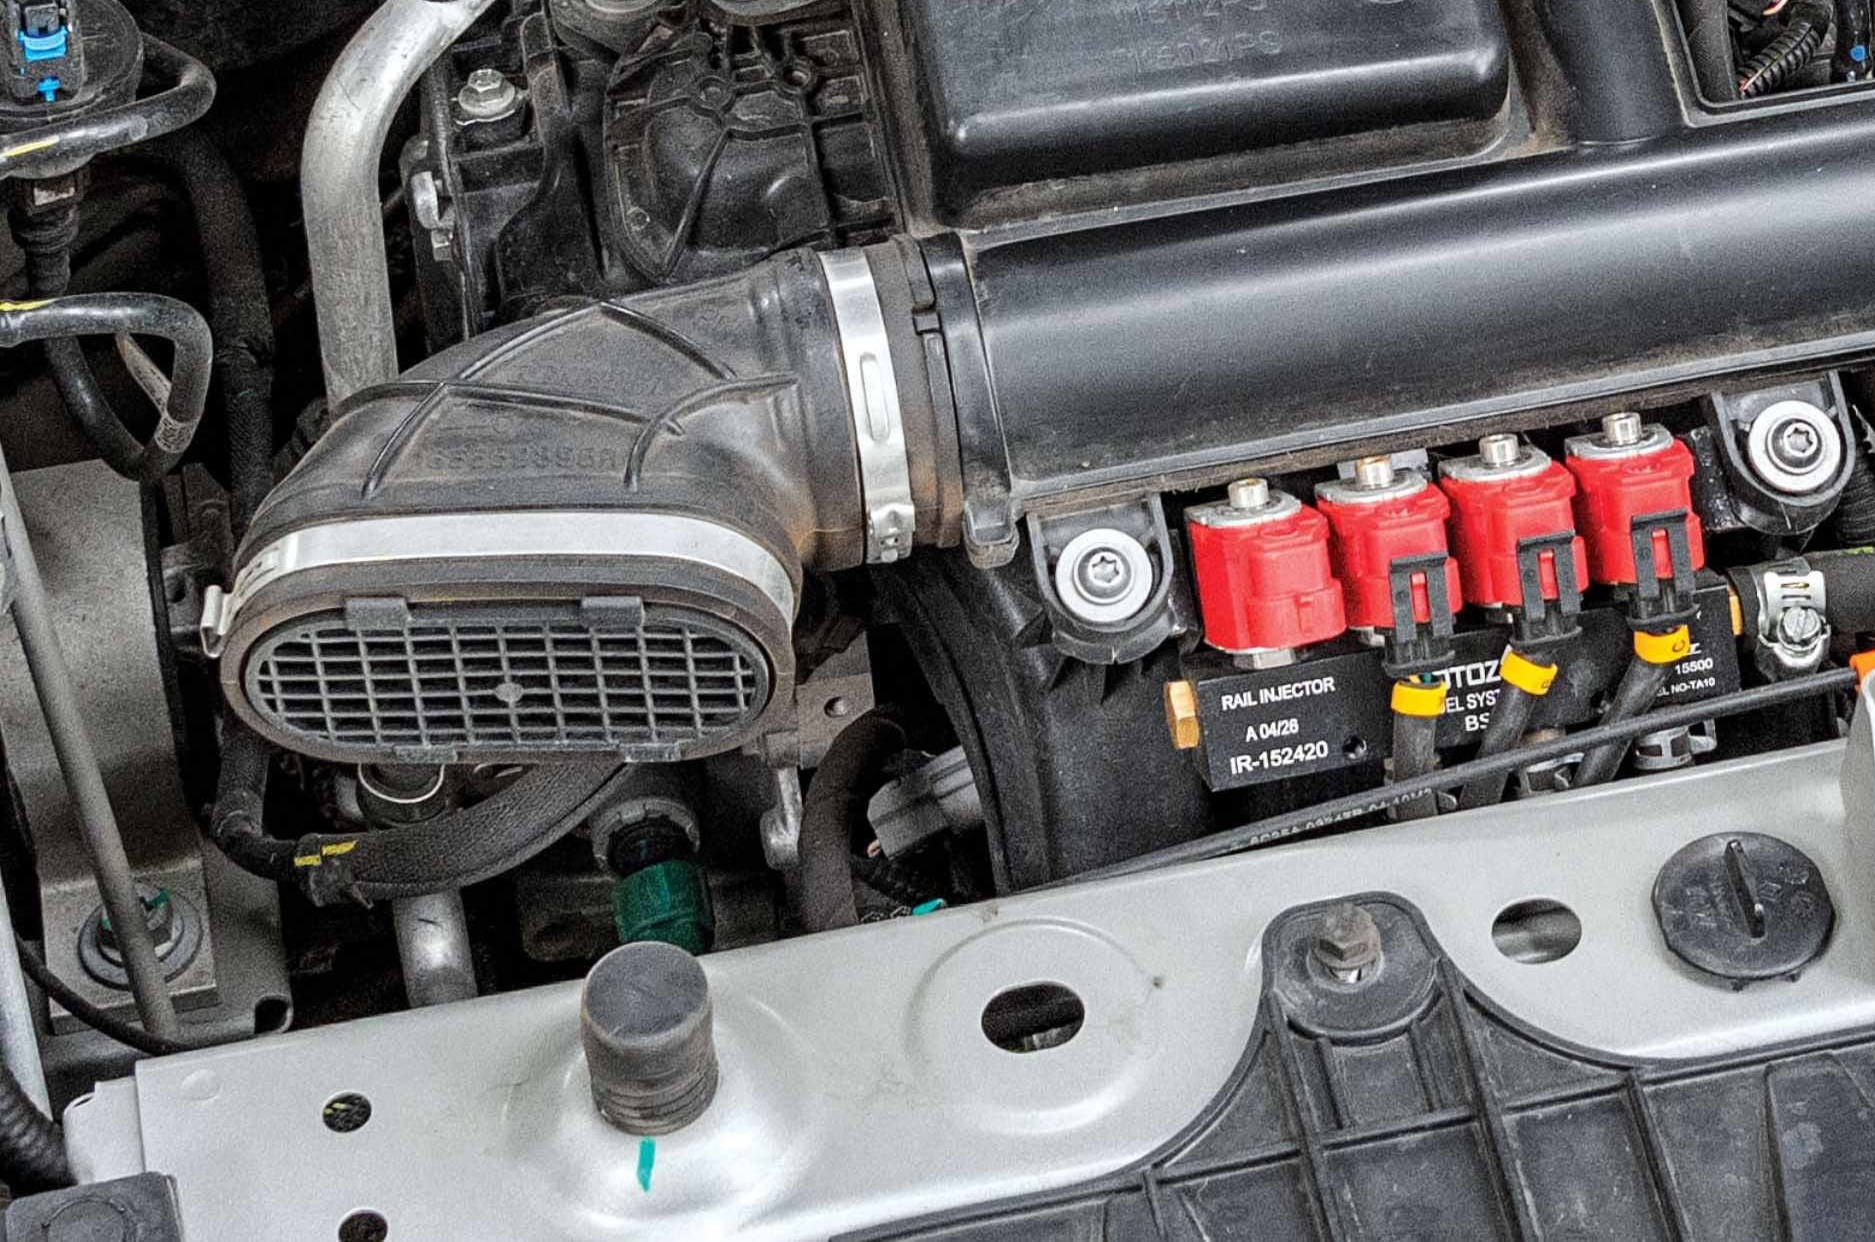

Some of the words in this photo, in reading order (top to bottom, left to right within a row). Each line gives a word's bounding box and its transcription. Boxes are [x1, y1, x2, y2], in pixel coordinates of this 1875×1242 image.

[1675, 657, 1714, 675] 15500
[1221, 690, 1258, 711] RAIL
[1259, 676, 1336, 704] INJECTOR
[1445, 695, 1465, 714] EL
[1245, 725, 1259, 743] A
[1230, 740, 1329, 775] IR-152420
